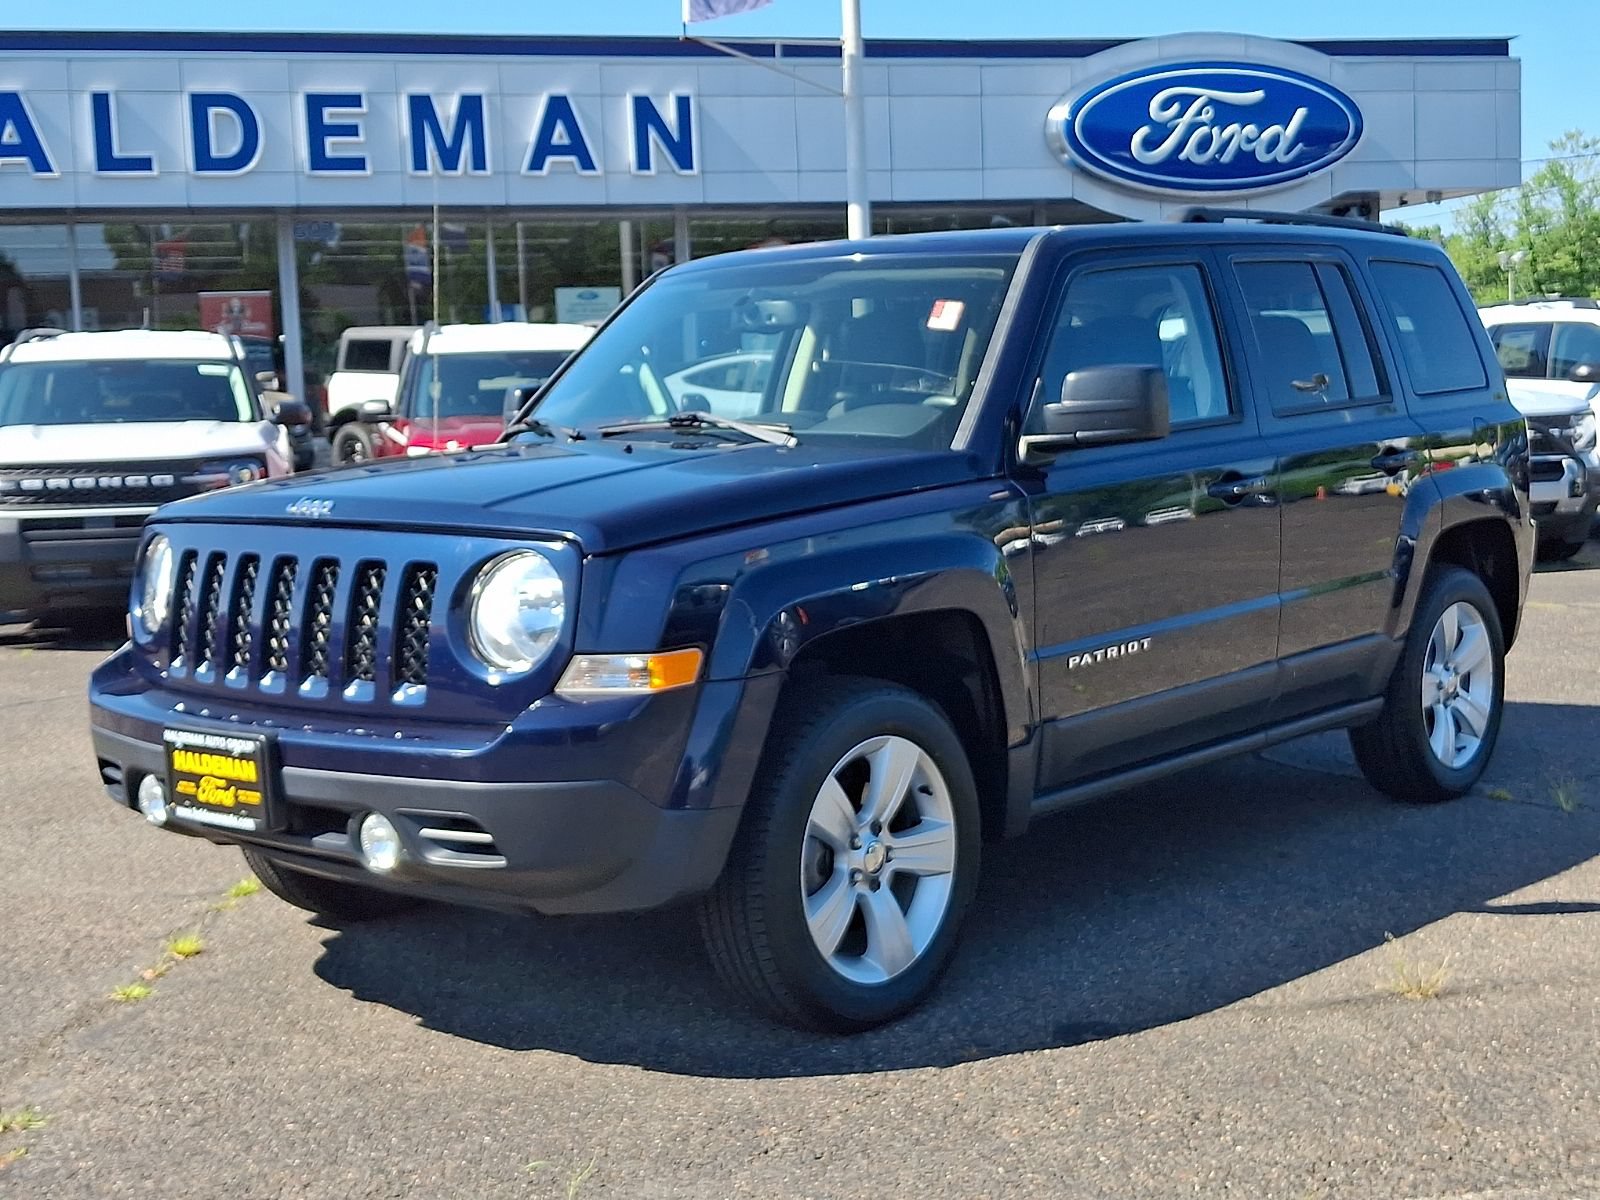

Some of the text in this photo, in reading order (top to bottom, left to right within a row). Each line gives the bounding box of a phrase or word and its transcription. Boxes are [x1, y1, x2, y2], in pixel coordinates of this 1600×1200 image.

[1131, 86, 1308, 164] Ford
[286, 496, 335, 519] Jeep
[1067, 637, 1152, 669] PATRIOT
[173, 750, 257, 782] HALDEMAN
[197, 775, 236, 808] Ford
